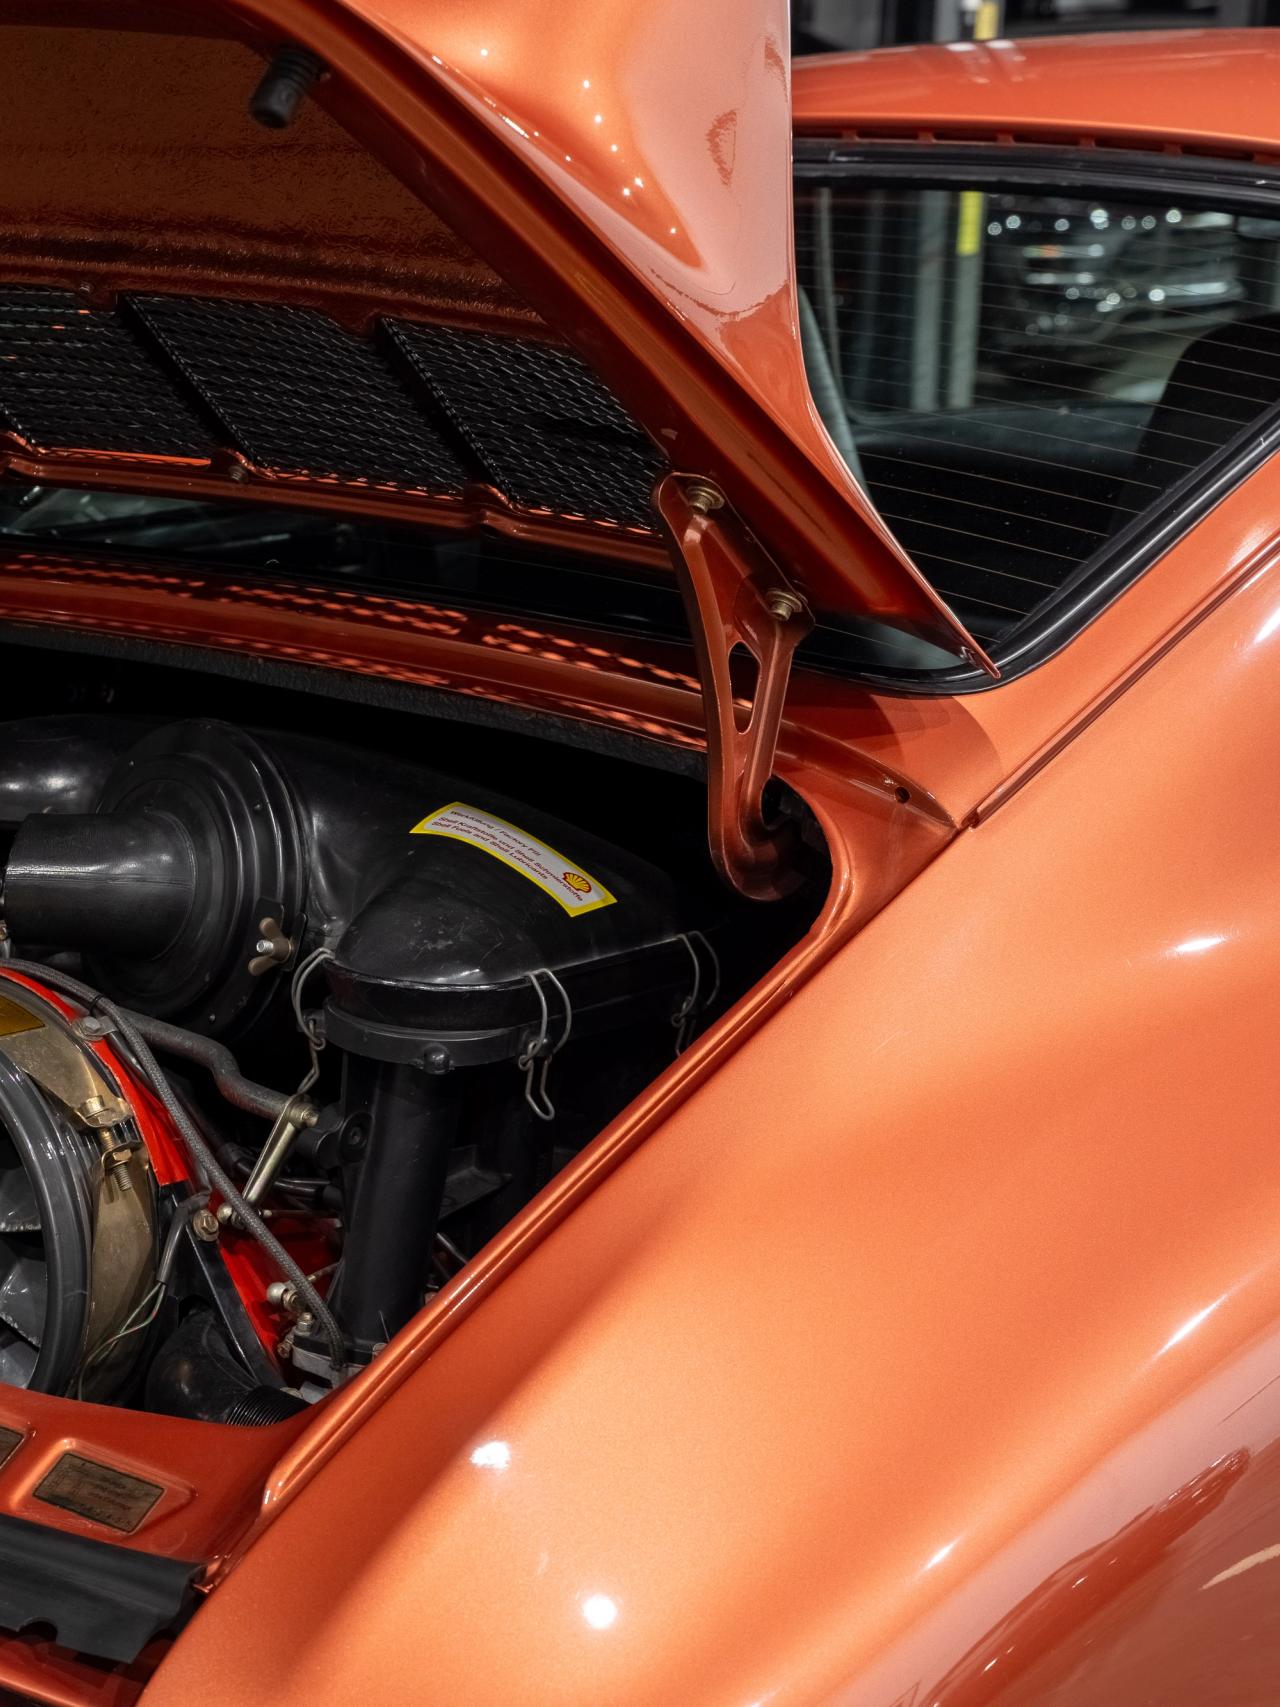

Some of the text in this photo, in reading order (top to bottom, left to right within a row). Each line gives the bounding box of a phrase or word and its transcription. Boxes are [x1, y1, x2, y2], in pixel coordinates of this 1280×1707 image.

[431, 821, 548, 880] Shell Fuels and Shell Lubricants
[438, 816, 459, 824] Shell
[498, 840, 515, 850] und
[514, 849, 535, 863] Shell
[534, 862, 583, 902] Schmierstoffe
[500, 829, 528, 848] Factory
